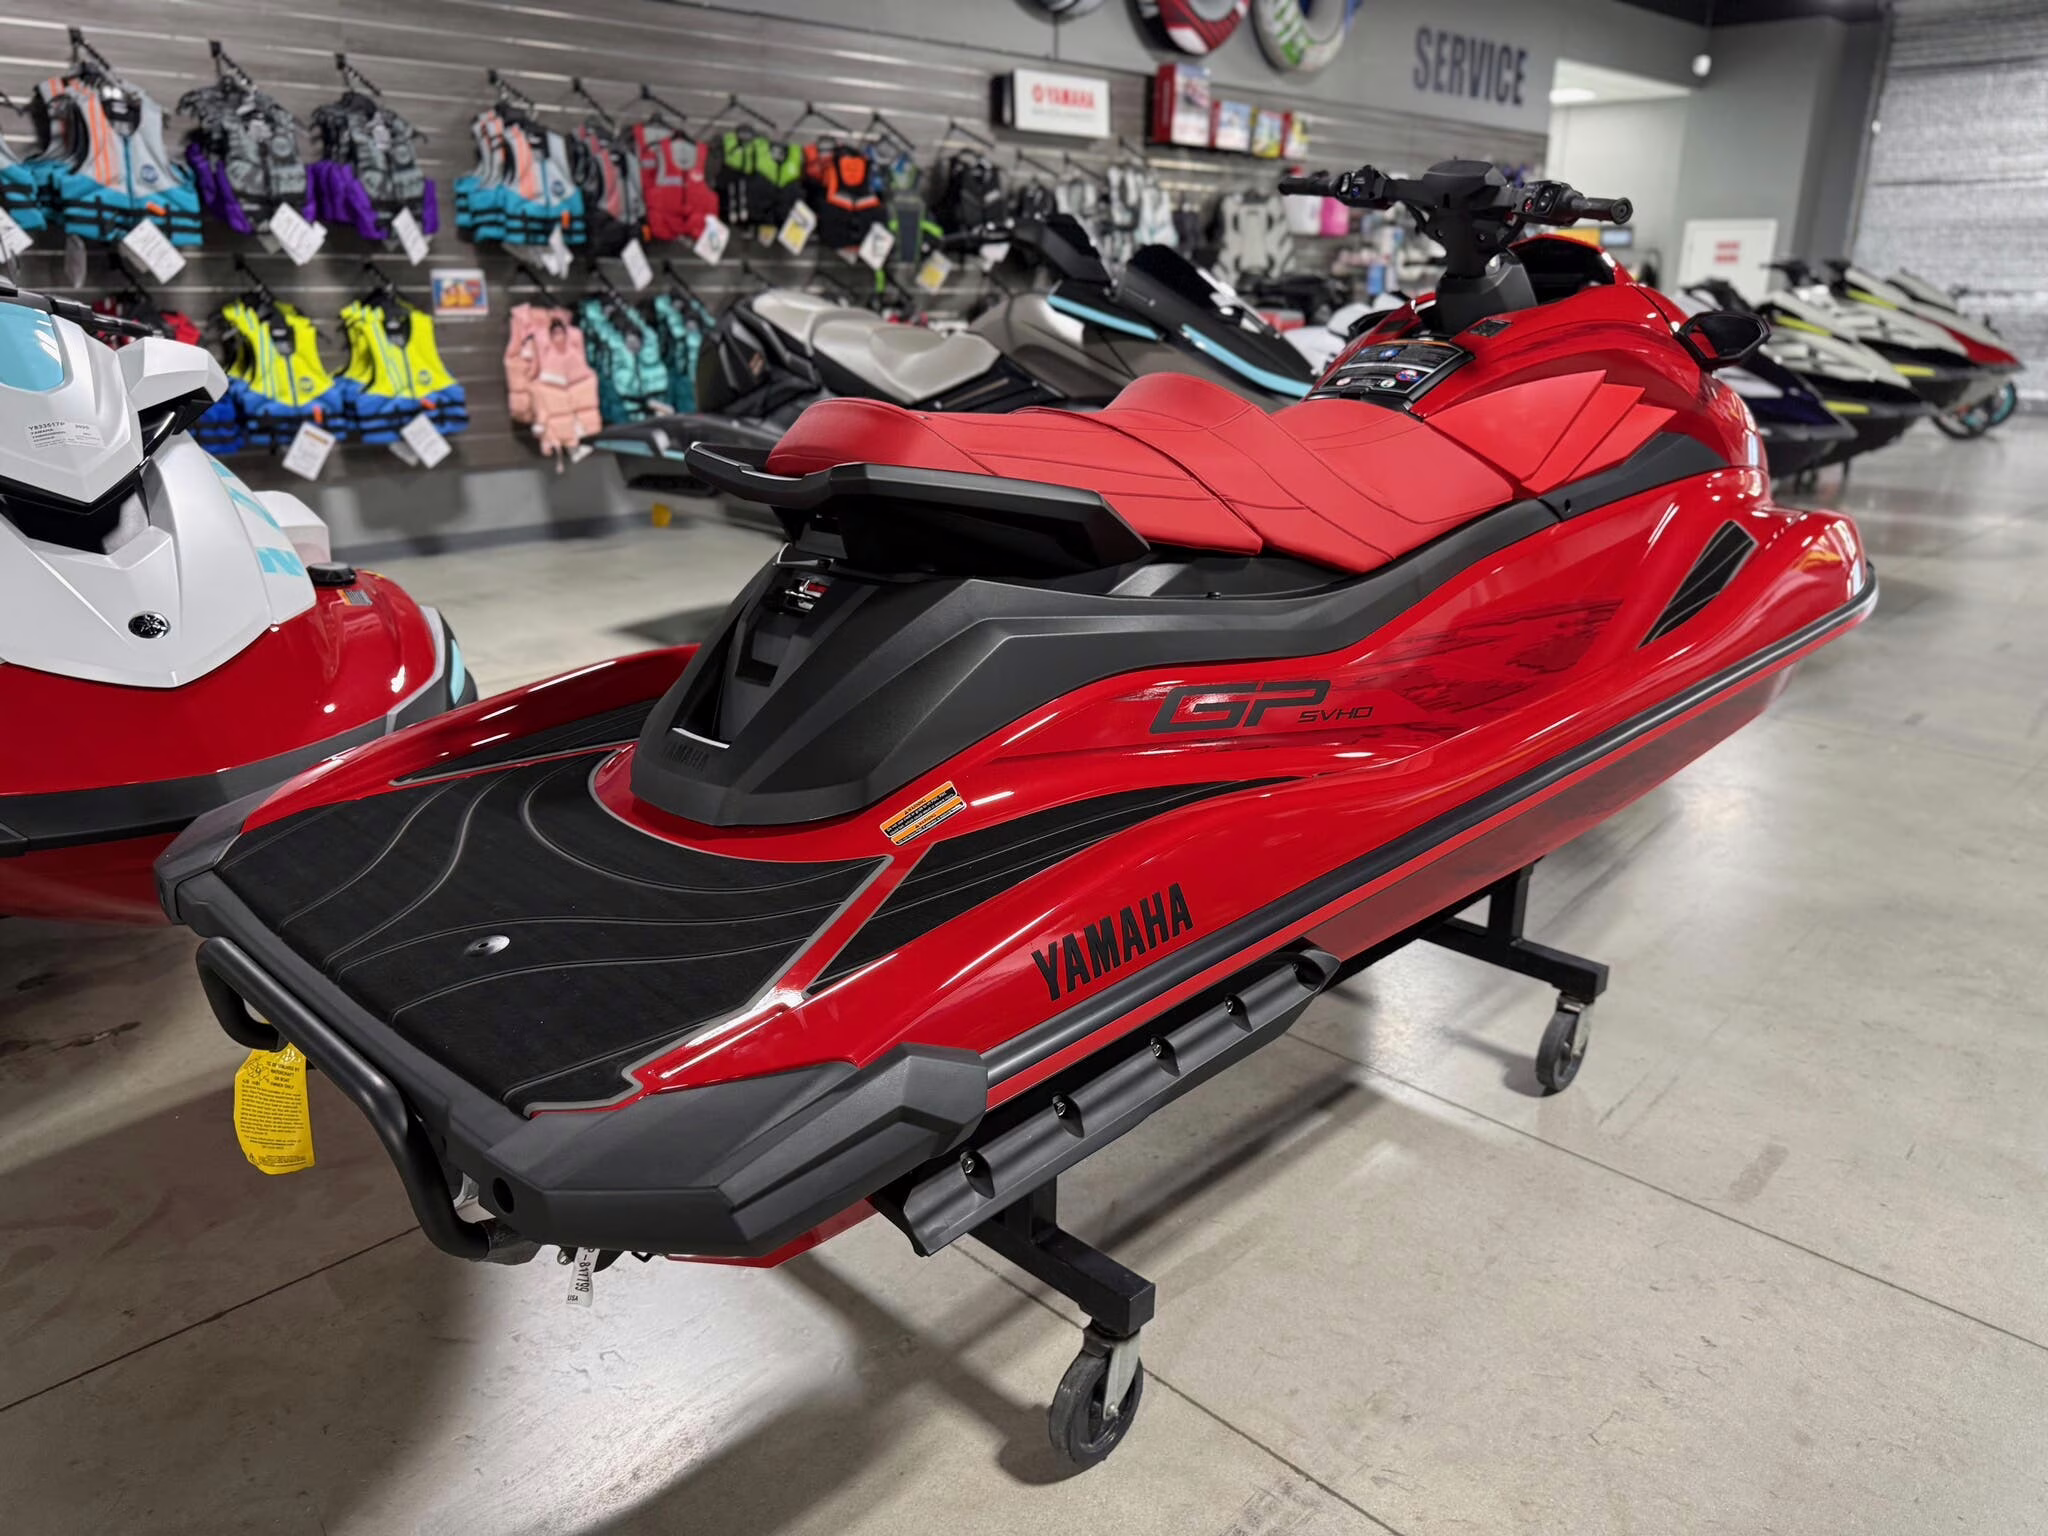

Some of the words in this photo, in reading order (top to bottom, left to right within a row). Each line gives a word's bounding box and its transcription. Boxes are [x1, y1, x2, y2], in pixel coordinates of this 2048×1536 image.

[1413, 26, 1526, 105] SERVICE
[1047, 85, 1096, 110] YAMAHA
[1150, 679, 1331, 735] GP
[1297, 706, 1374, 724] SVHO
[1031, 882, 1194, 1002] YAMAHA
[567, 1294, 579, 1302] USA
